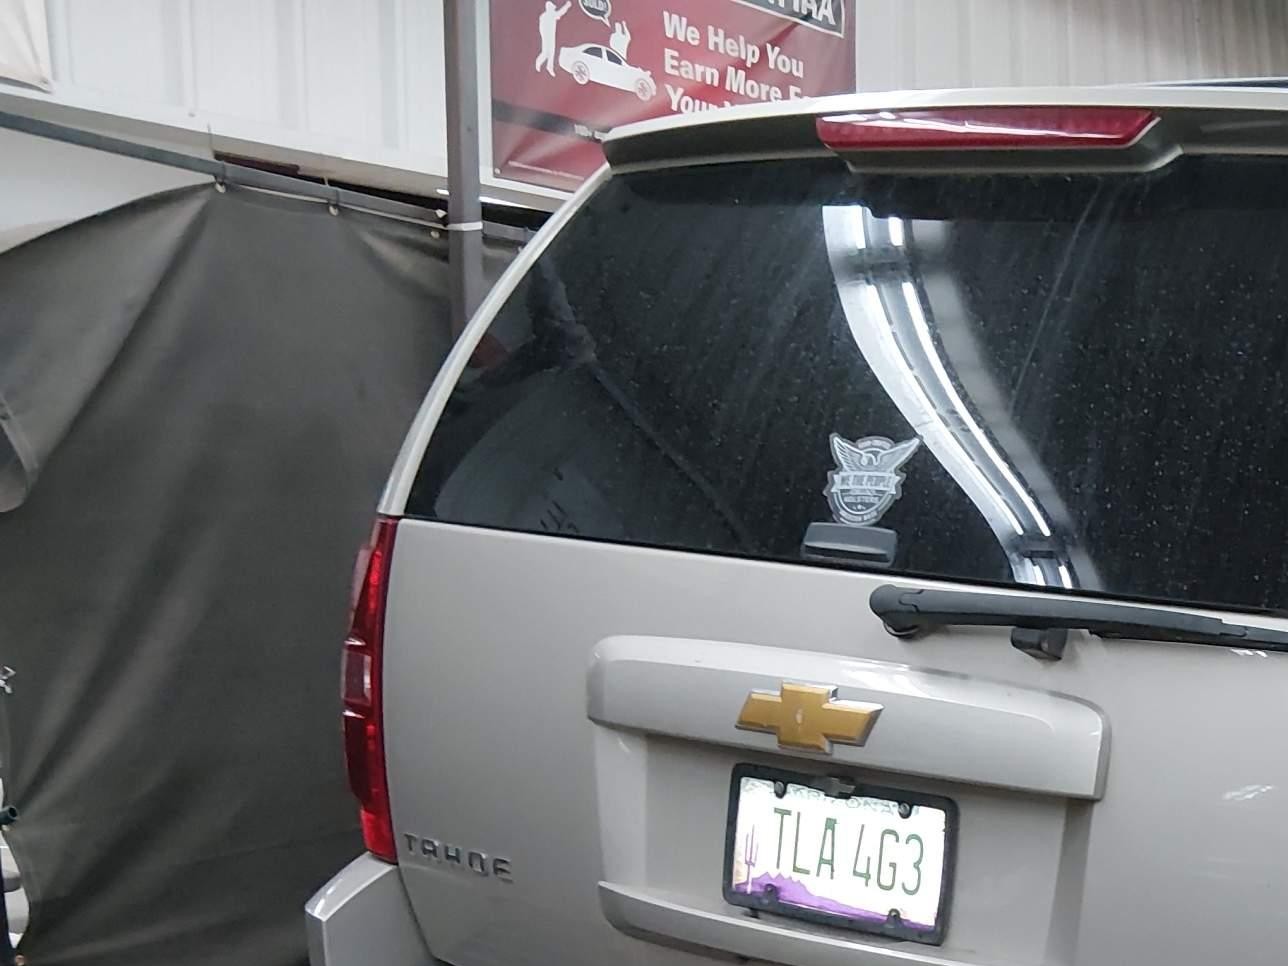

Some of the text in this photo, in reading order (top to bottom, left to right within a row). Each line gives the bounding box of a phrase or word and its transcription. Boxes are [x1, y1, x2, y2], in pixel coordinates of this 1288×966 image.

[663, 10, 804, 78] We Help You
[664, 48, 782, 102] Earn More
[402, 832, 514, 883] TAHOE
[774, 807, 924, 896] TLA 4G3
